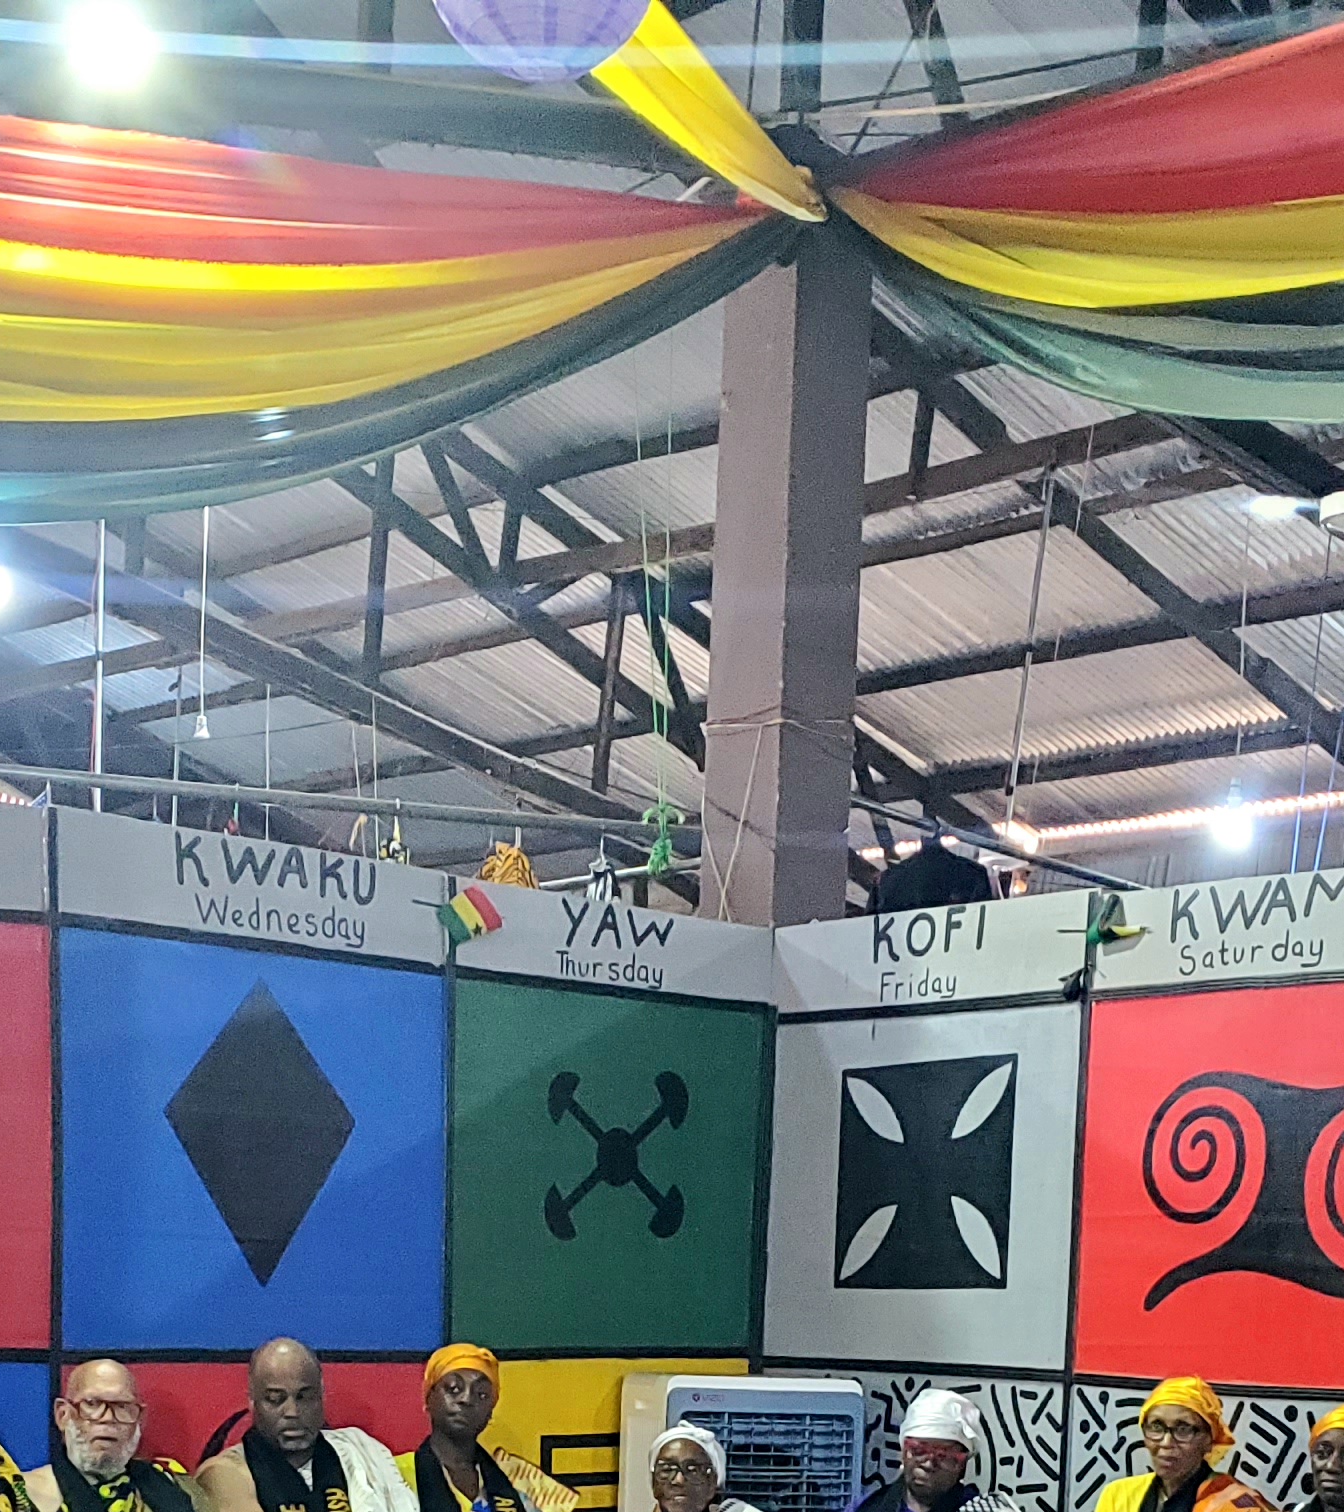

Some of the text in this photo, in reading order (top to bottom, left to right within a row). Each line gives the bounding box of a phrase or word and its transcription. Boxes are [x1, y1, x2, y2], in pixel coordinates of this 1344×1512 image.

[175, 830, 377, 907] KWAKU
[195, 893, 367, 949] Wednesday
[561, 898, 675, 950] YAW
[872, 905, 986, 964] KOFI
[556, 950, 665, 989] Thursday
[1180, 931, 1326, 976] Saturday
[879, 969, 959, 1003] Friday
